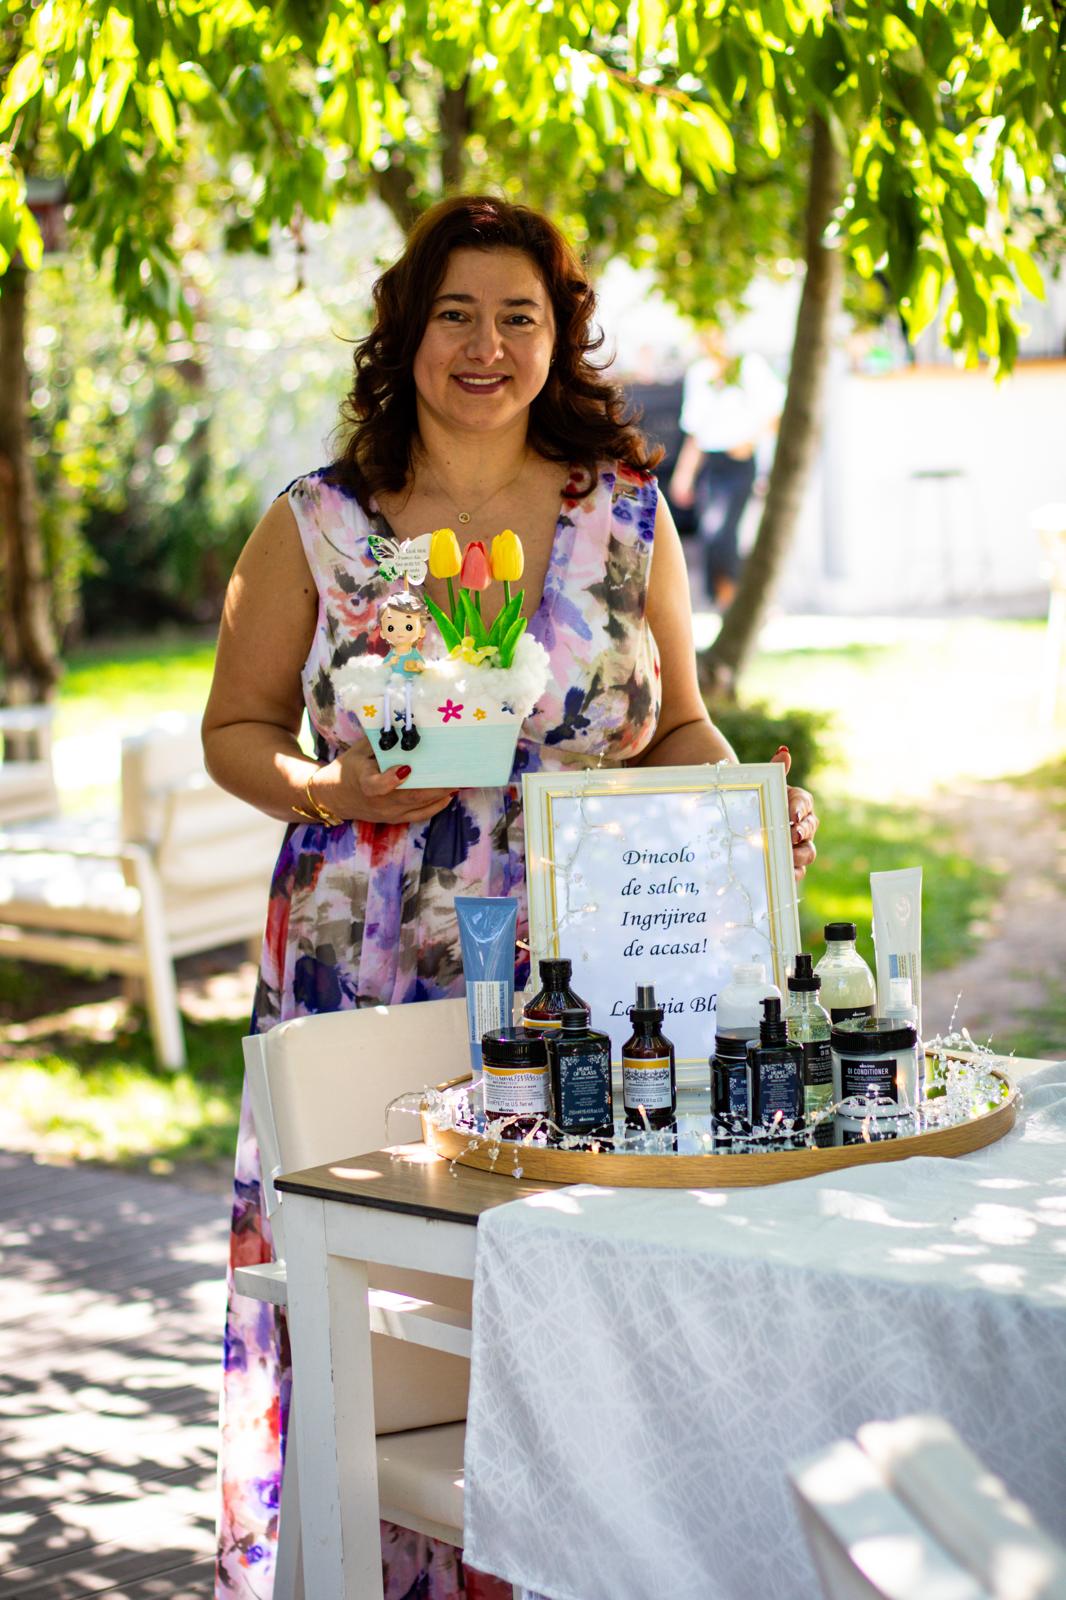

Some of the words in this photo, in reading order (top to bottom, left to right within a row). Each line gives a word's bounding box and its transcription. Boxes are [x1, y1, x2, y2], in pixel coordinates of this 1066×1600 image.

[622, 846, 695, 865] Dincolo
[621, 877, 641, 896] de
[647, 876, 700, 896] salon,
[620, 908, 707, 932] Ingrijirea
[623, 938, 644, 957] de
[649, 938, 708, 956] acasa!
